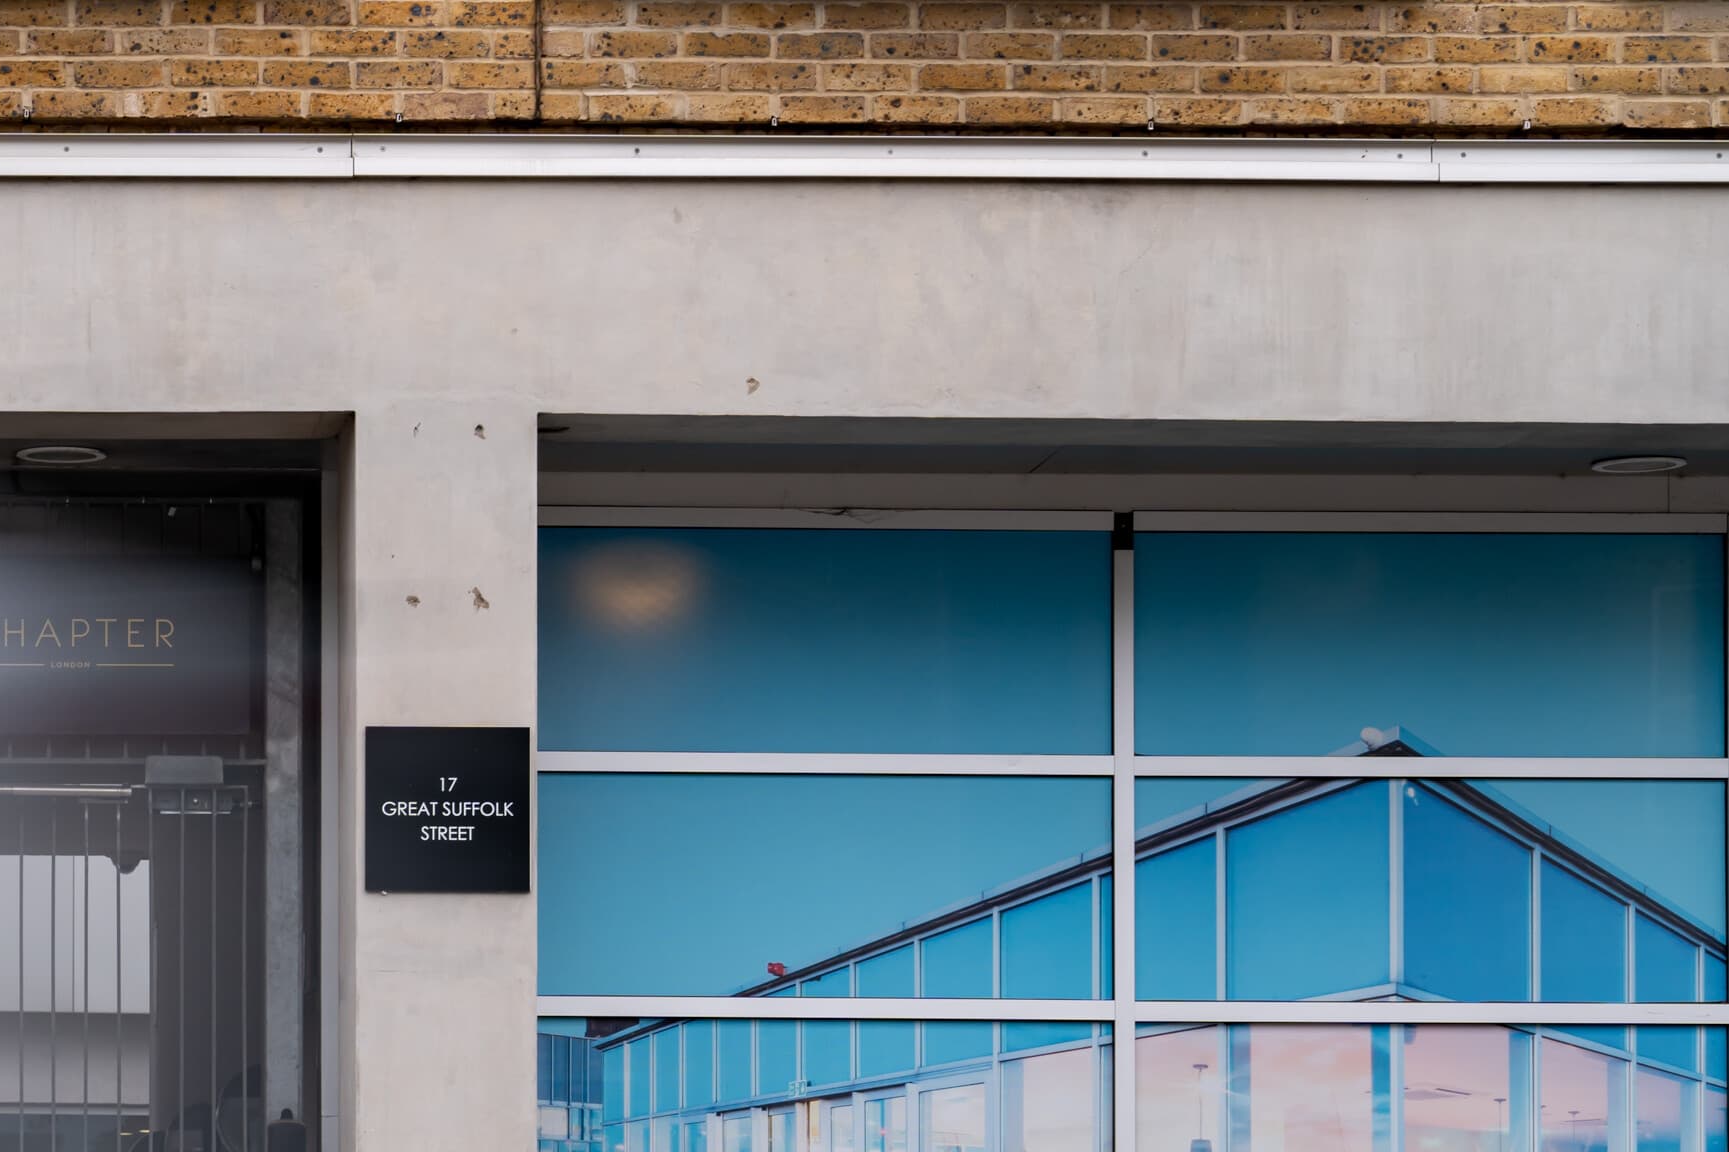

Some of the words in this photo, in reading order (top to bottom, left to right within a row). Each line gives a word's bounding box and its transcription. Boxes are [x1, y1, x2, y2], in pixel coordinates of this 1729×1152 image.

[50, 660, 91, 669] LONDON
[439, 776, 459, 793] 17
[381, 800, 439, 817] GREAT
[441, 800, 515, 817] SUFFOLK
[420, 825, 476, 841] STREET
